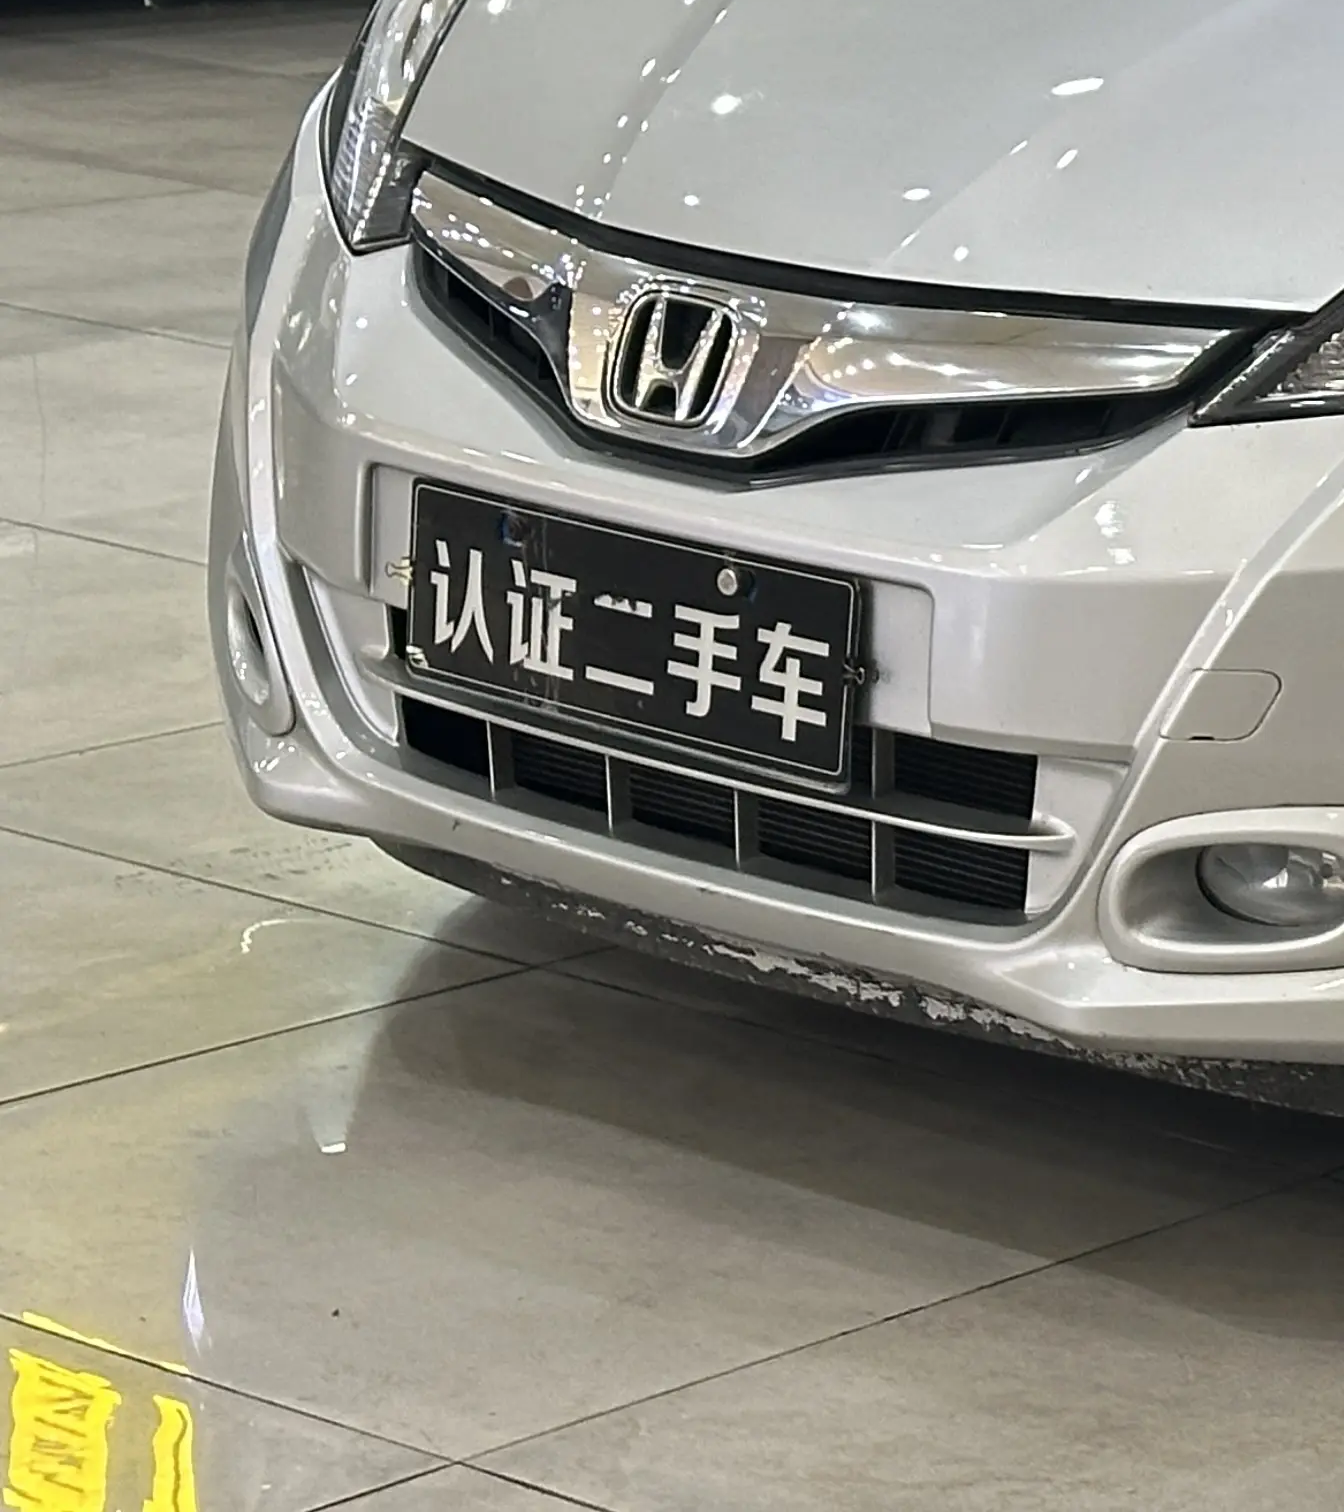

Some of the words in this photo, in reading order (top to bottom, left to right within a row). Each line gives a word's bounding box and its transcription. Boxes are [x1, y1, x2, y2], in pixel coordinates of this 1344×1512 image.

[430, 539, 831, 742] 认证二手车
